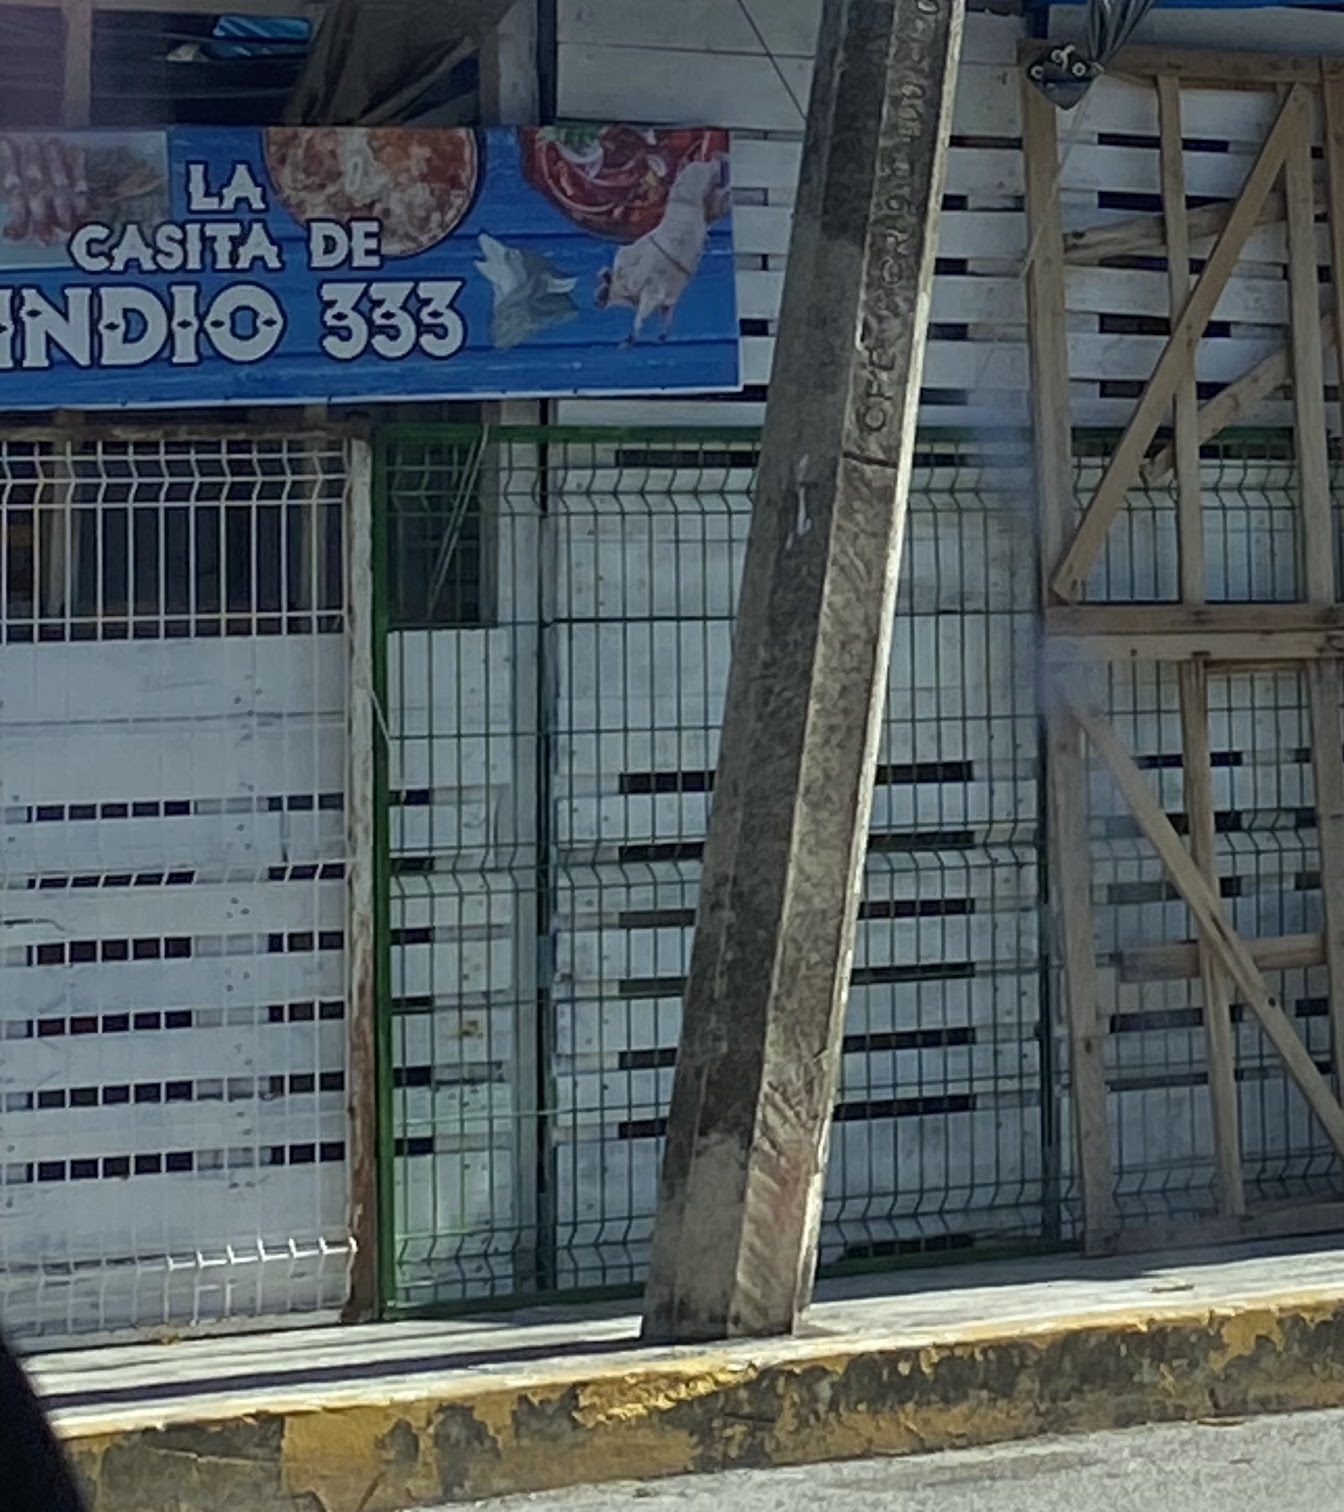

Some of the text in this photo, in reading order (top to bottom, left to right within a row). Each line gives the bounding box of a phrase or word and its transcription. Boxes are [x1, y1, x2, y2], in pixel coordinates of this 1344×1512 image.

[188, 162, 267, 211] LA
[69, 221, 383, 272] CASITA DE
[320, 281, 465, 360] 333
